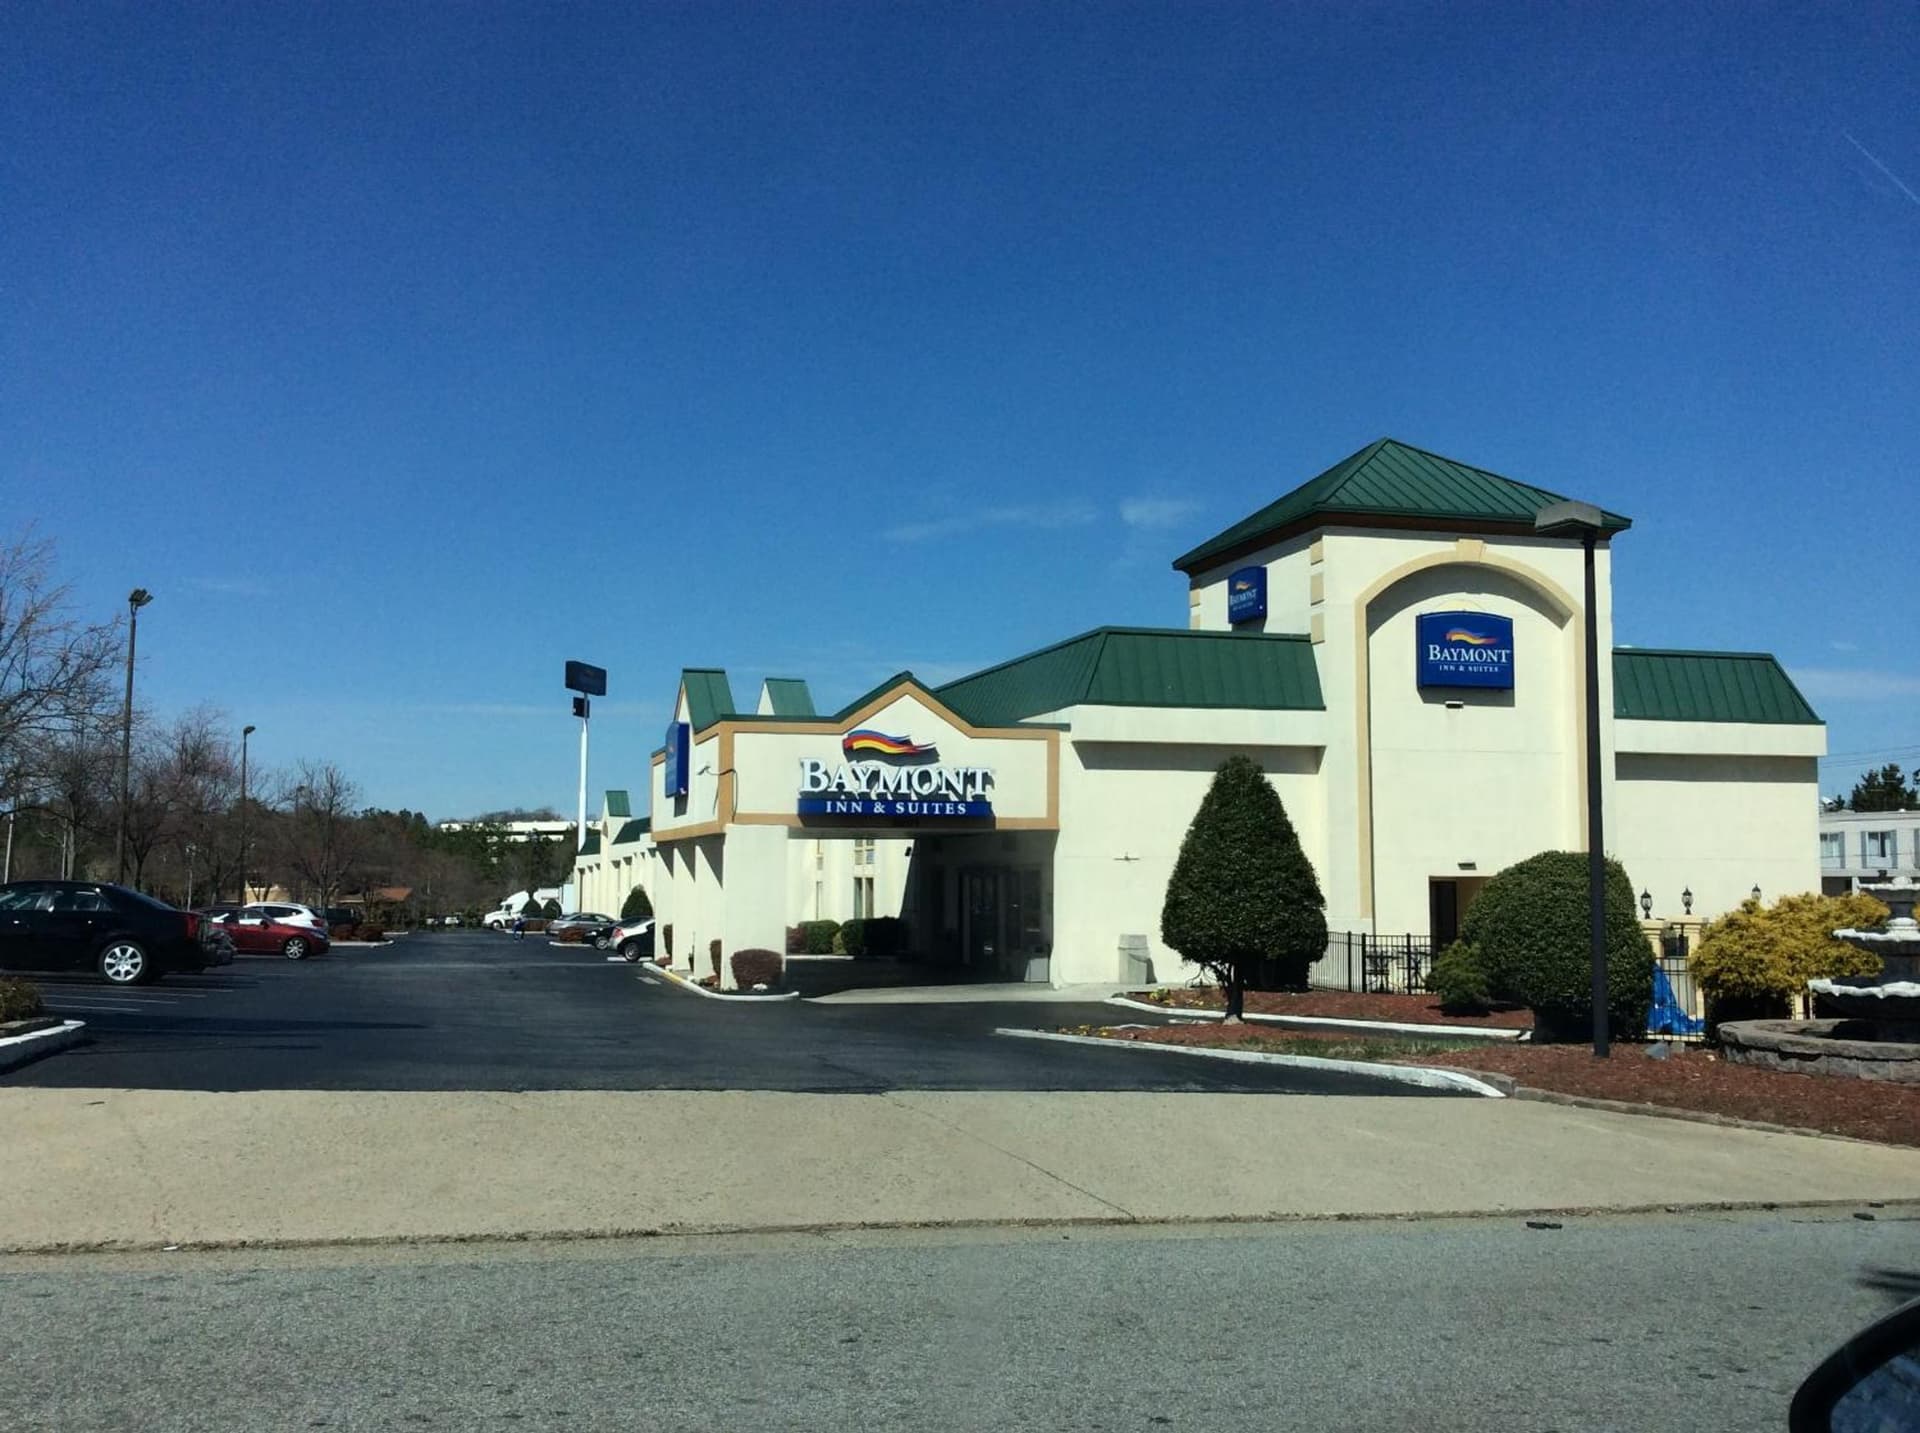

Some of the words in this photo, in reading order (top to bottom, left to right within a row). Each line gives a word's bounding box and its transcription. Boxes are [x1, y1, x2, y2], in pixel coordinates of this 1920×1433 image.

[1428, 644, 1511, 663] BAYMONT
[801, 758, 990, 796] BAYMONT
[826, 801, 863, 813] INN
[873, 802, 885, 814] &
[895, 802, 967, 815] SUITES
